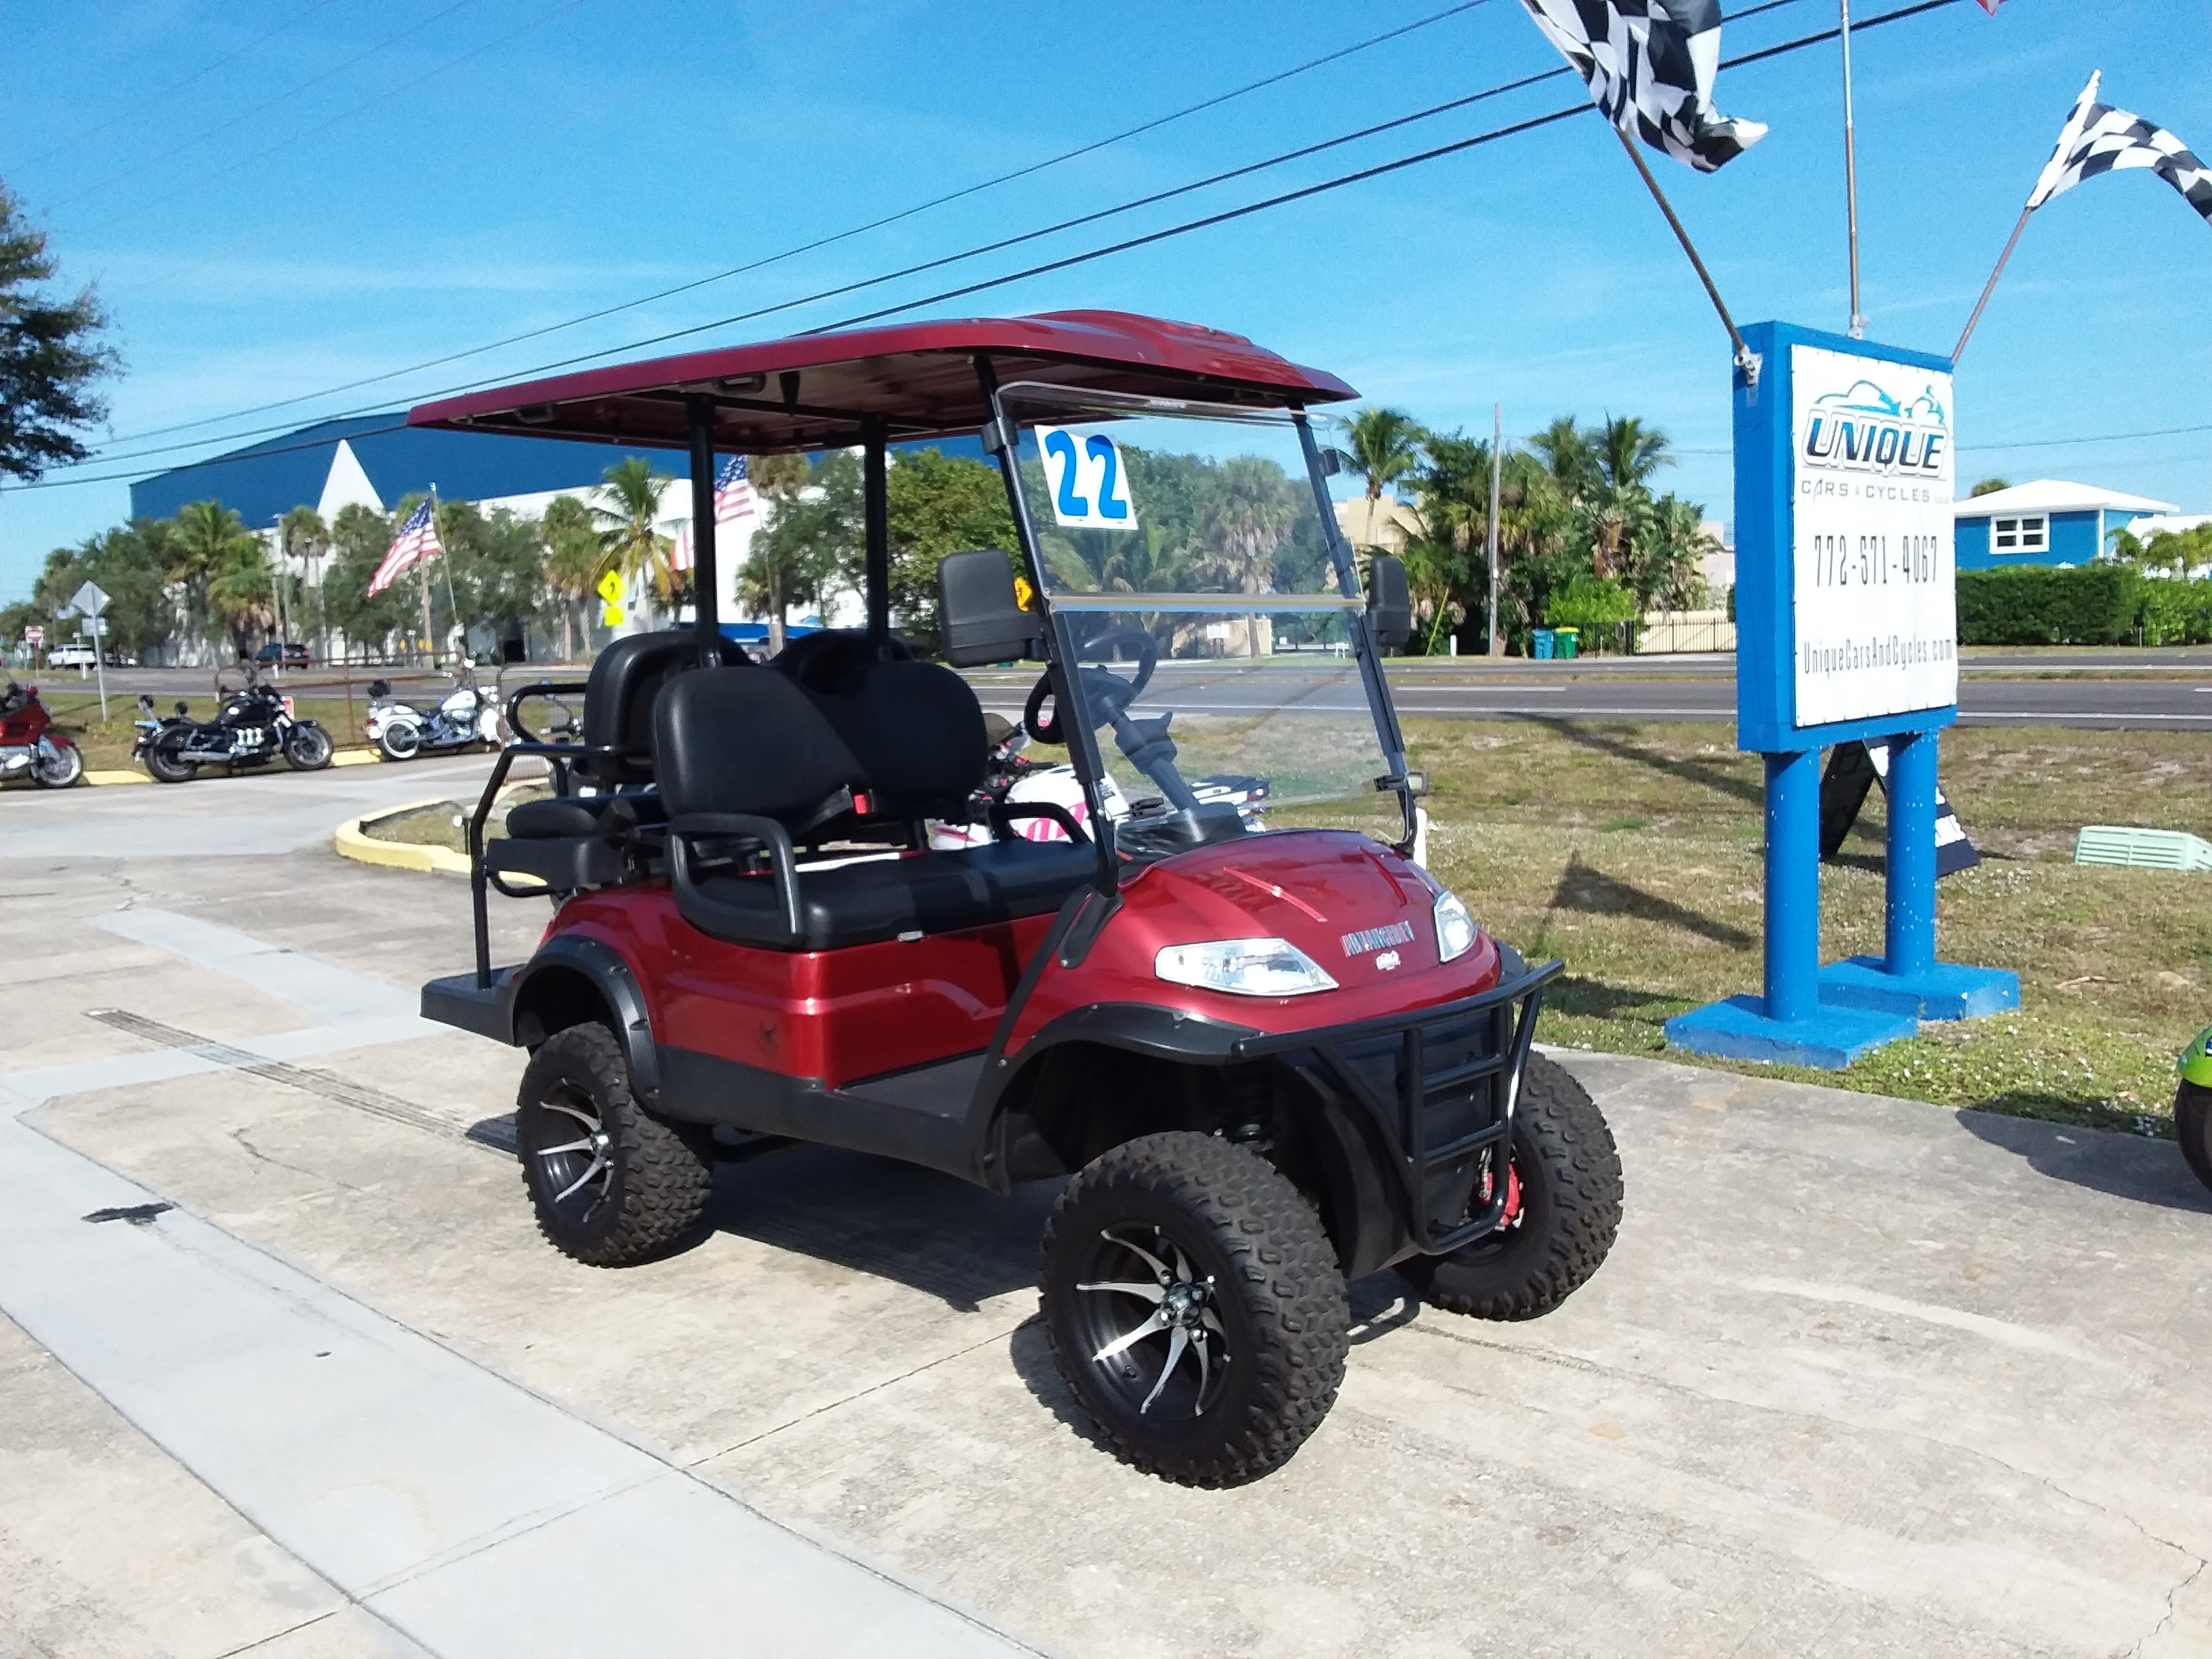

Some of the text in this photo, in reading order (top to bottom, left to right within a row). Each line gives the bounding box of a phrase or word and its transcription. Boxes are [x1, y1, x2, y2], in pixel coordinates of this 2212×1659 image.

[1806, 417, 1945, 470] UNIQUE
[1044, 430, 1127, 519] 22
[1801, 478, 1848, 506] CARS
[1866, 485, 1929, 503] CYCLES
[1815, 535, 1936, 587] 772-571-4067
[1804, 634, 1952, 678] UniqueCarsAndCycles.com
